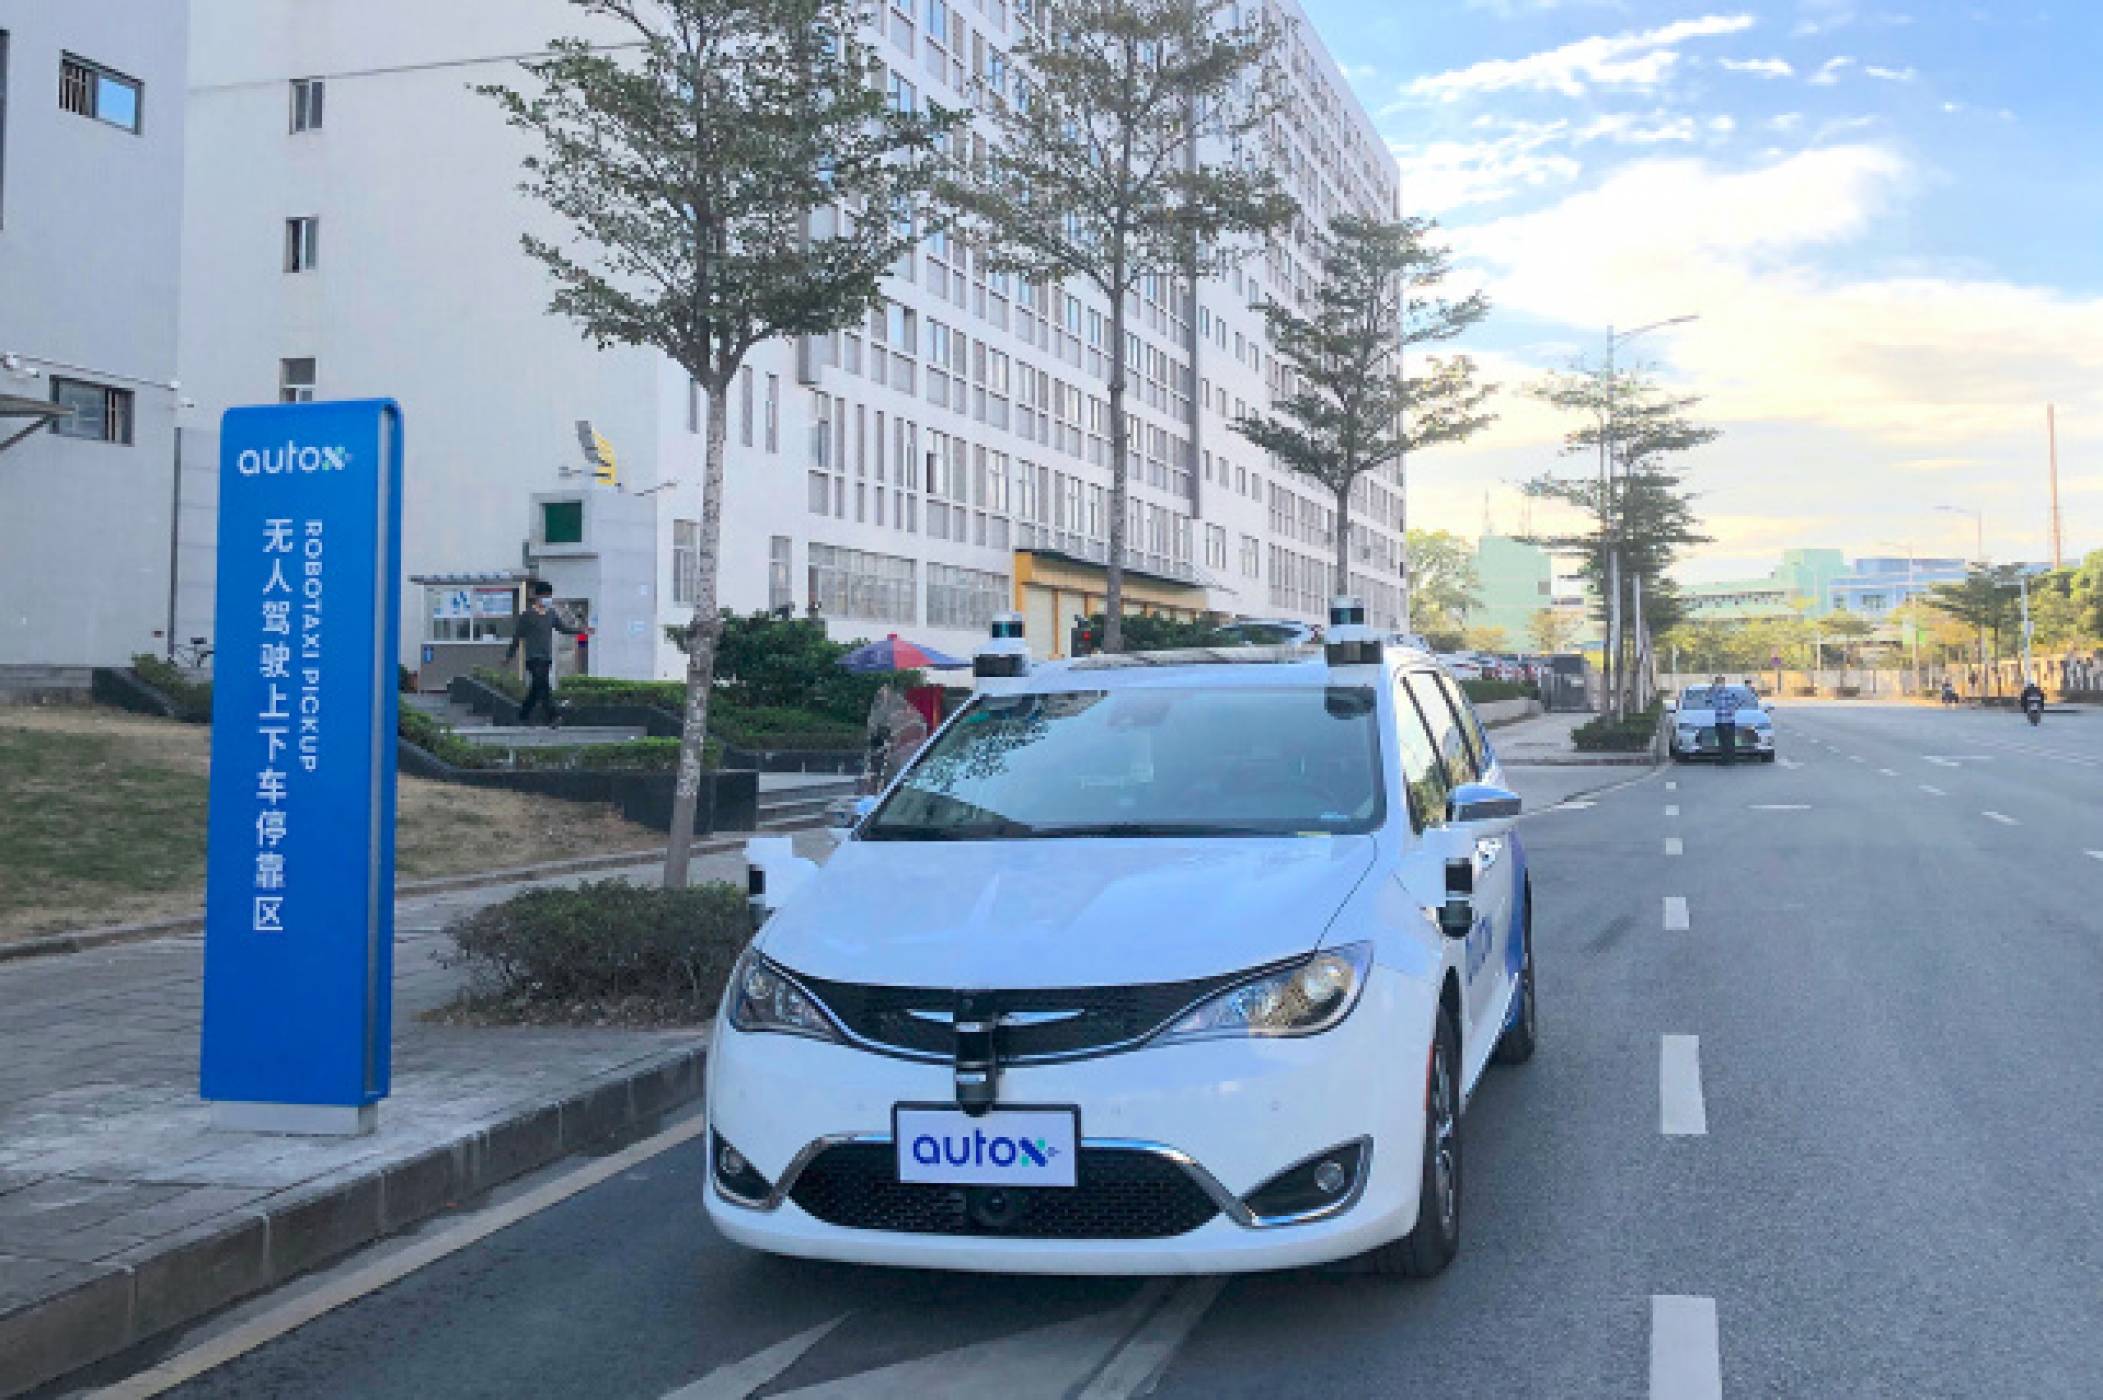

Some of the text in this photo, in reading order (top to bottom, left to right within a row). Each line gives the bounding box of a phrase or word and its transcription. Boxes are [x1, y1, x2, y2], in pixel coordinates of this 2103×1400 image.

[253, 518, 294, 931] 无人驾驶上下车停靠区
[299, 519, 323, 772] ROBOTAXI PICKUP
